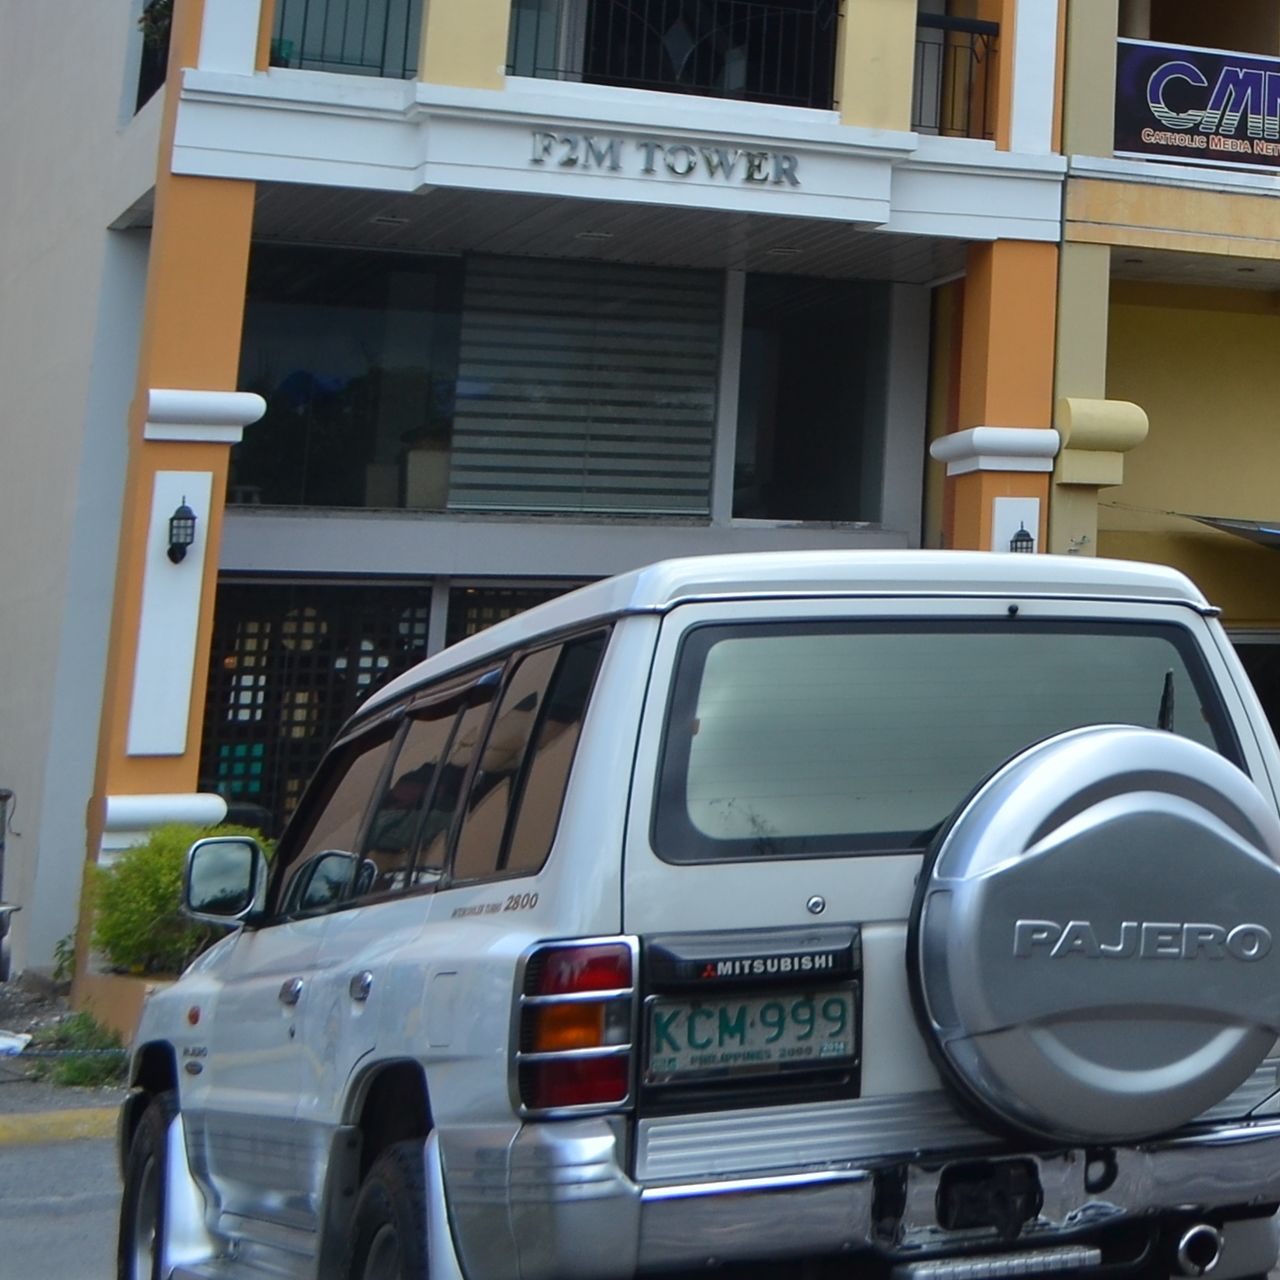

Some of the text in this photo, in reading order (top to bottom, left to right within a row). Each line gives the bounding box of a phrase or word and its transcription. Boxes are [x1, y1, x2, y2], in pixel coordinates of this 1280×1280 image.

[530, 131, 801, 187] F2M TOWER
[503, 893, 539, 911] 2800
[1013, 919, 1273, 962] PAJERO
[717, 954, 833, 976] MITSUBISHI
[653, 997, 847, 1054] KCM 999
